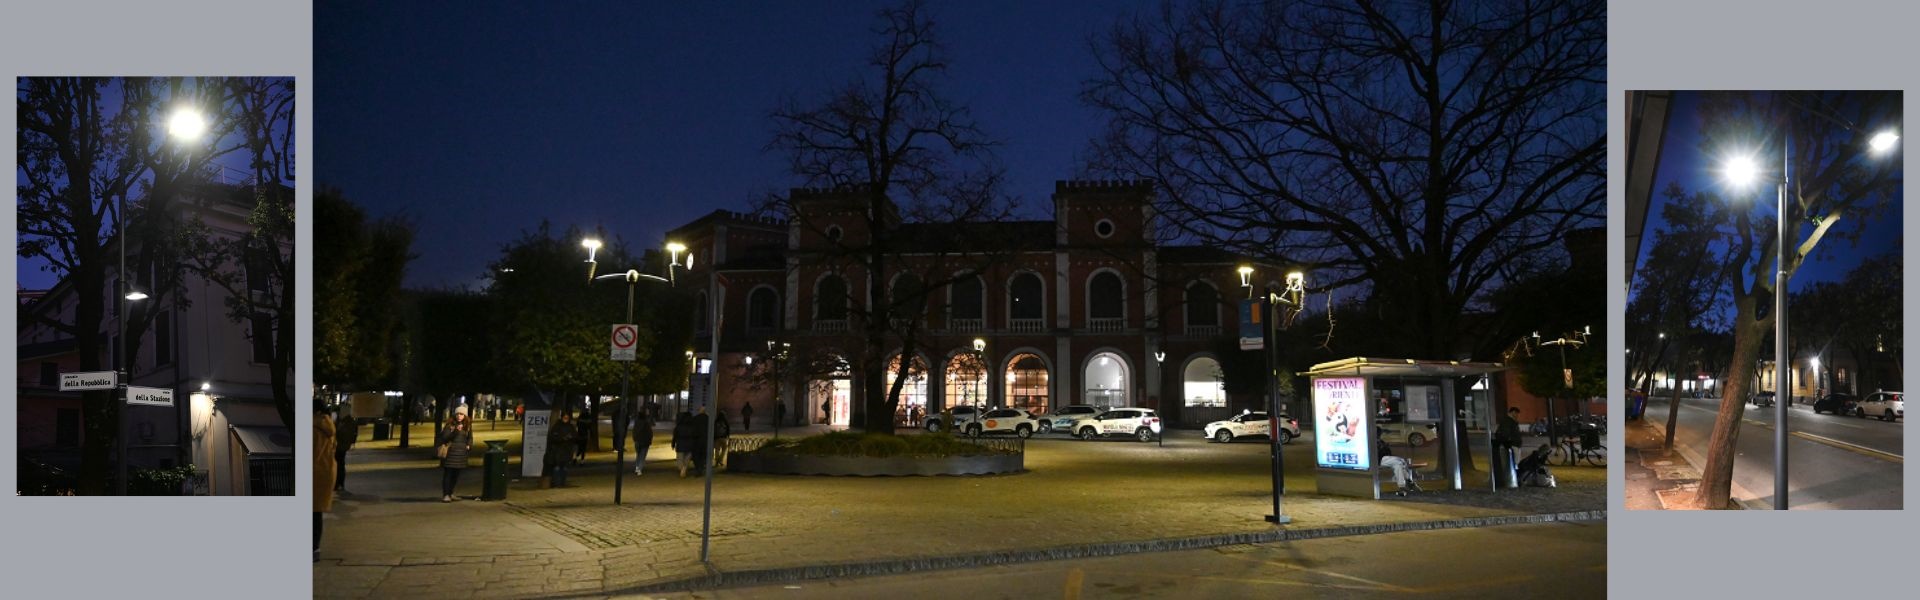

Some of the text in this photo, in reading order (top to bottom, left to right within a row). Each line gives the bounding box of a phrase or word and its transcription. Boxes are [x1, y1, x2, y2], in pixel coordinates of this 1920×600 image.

[81, 379, 111, 387] Repubblica
[1316, 380, 1360, 389] FESTIVAL
[150, 394, 171, 402] Stazione
[528, 415, 548, 426] ZEN
